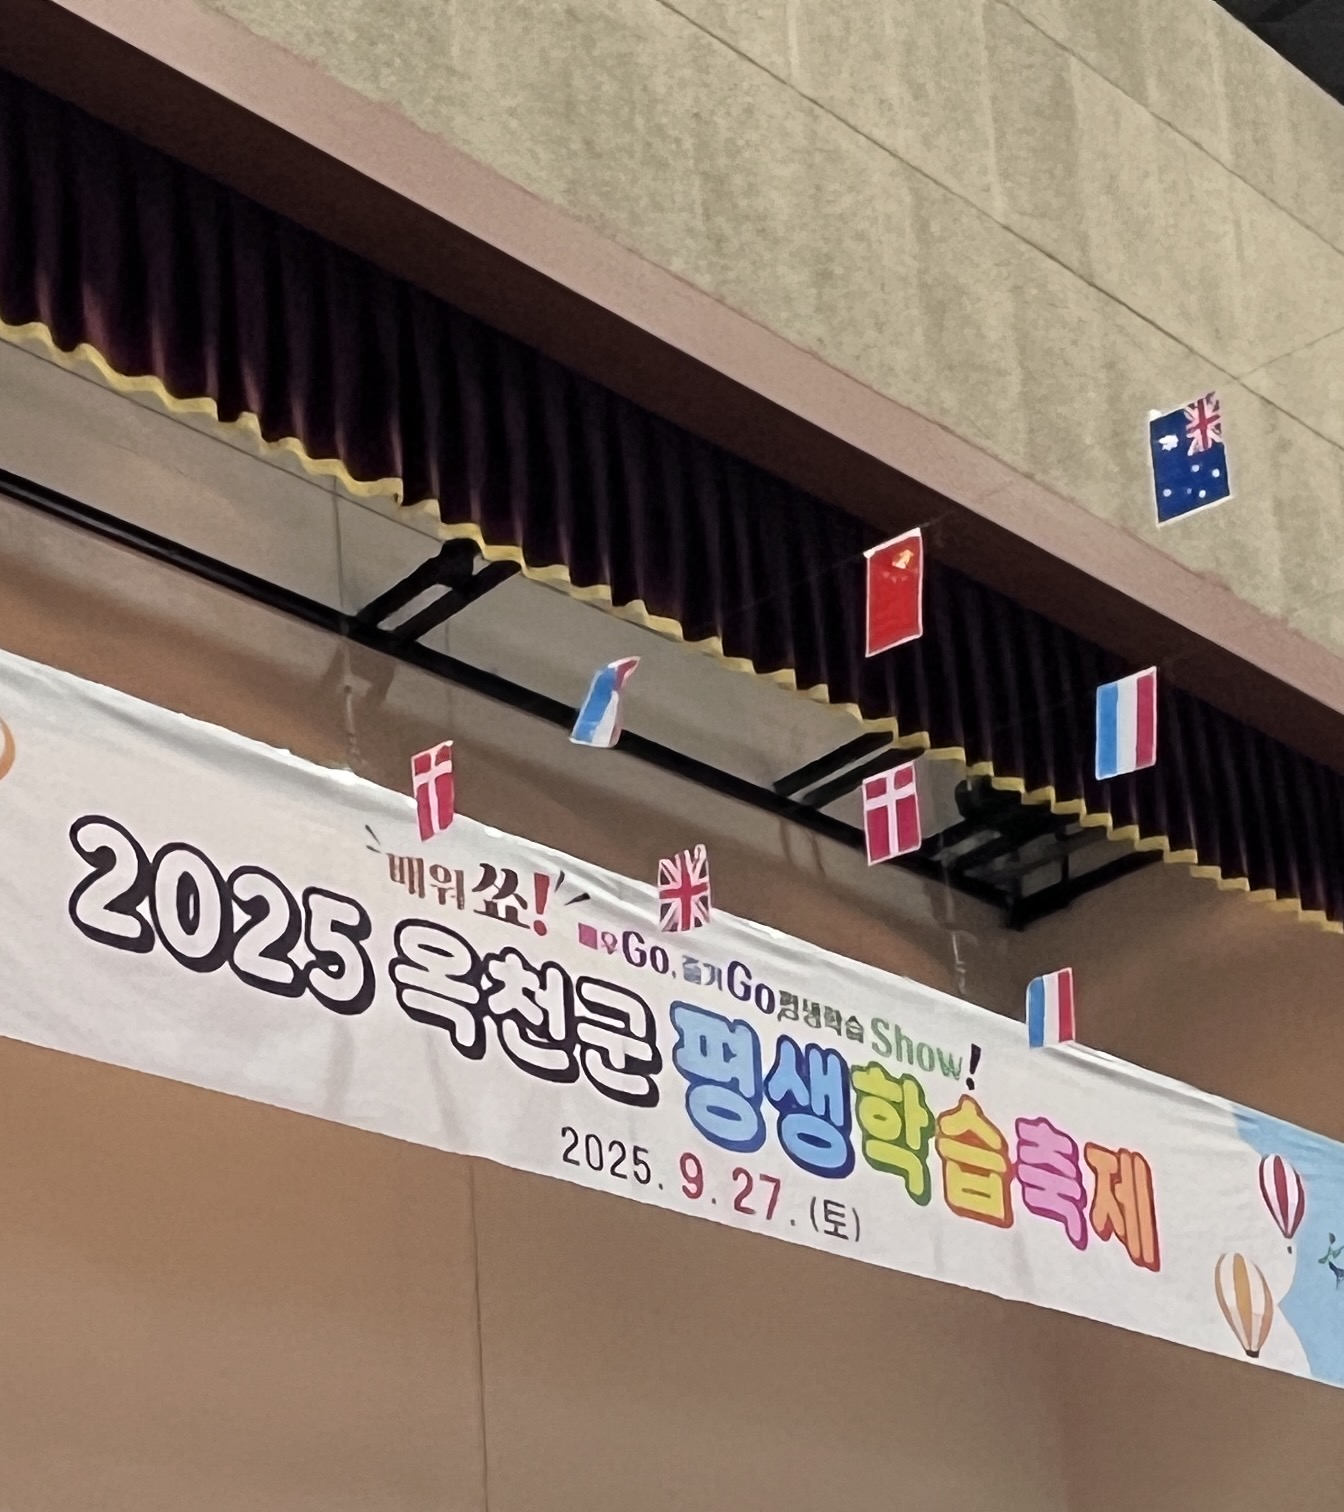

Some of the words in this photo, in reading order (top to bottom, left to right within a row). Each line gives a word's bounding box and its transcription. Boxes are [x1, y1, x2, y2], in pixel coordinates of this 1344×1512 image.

[69, 814, 375, 1015] 2025
[389, 918, 662, 1108] 옥천군
[670, 1000, 1161, 1272] 평생학습축제
[561, 1126, 664, 1191] 2025.
[679, 1152, 716, 1205] 9.
[731, 1167, 797, 1227] 27.
[809, 1196, 862, 1242] (토)
